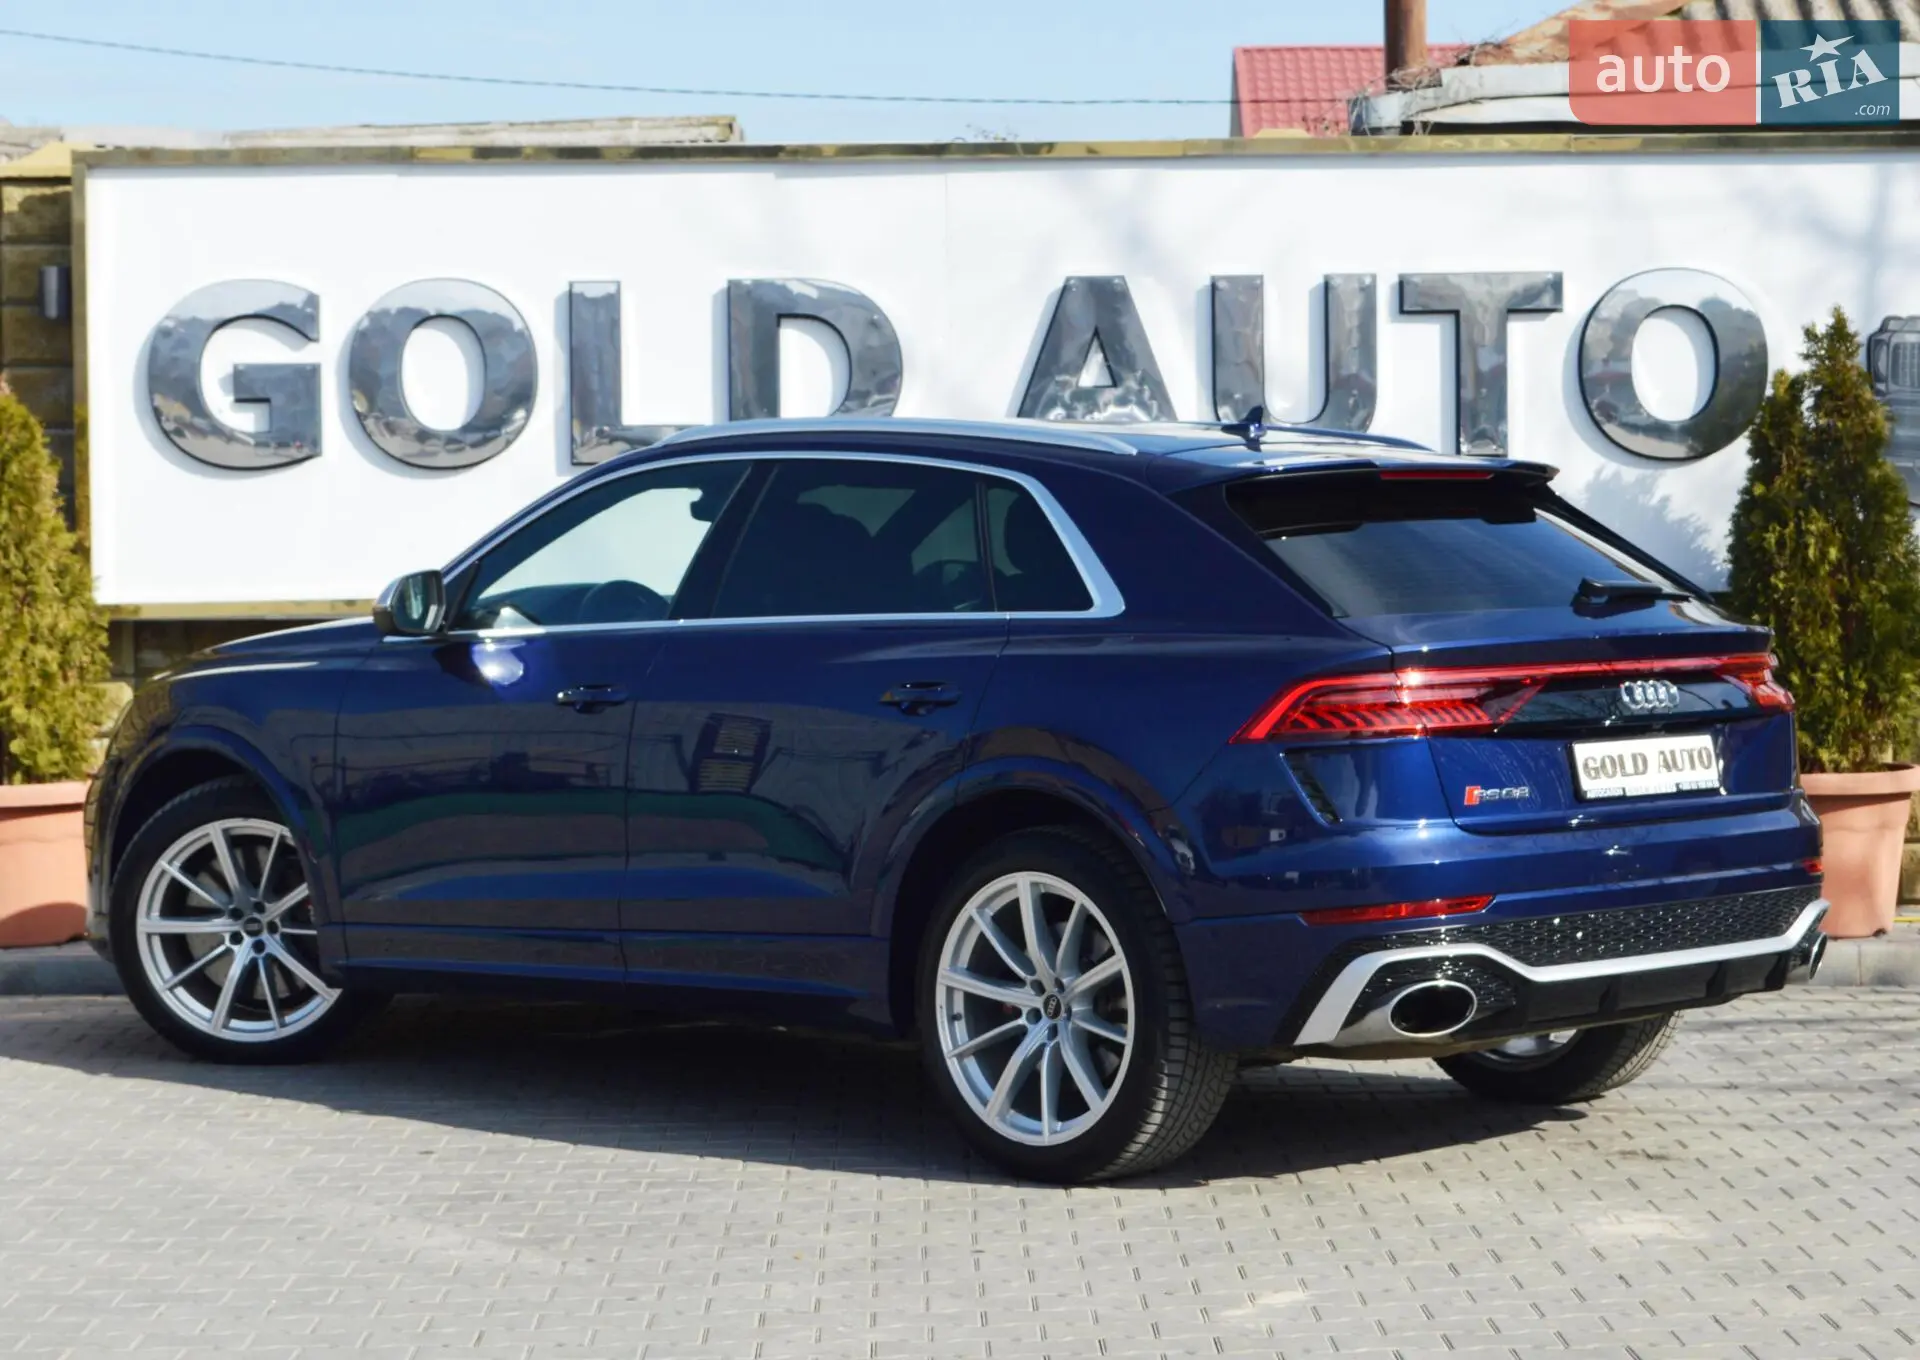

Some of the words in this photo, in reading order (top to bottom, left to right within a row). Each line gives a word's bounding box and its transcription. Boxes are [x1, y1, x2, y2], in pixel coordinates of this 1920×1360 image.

[147, 278, 904, 470] GOLD
[1018, 268, 1769, 460] AUTO
[1583, 752, 1648, 780] GOLD
[1658, 746, 1713, 773] AUTO
